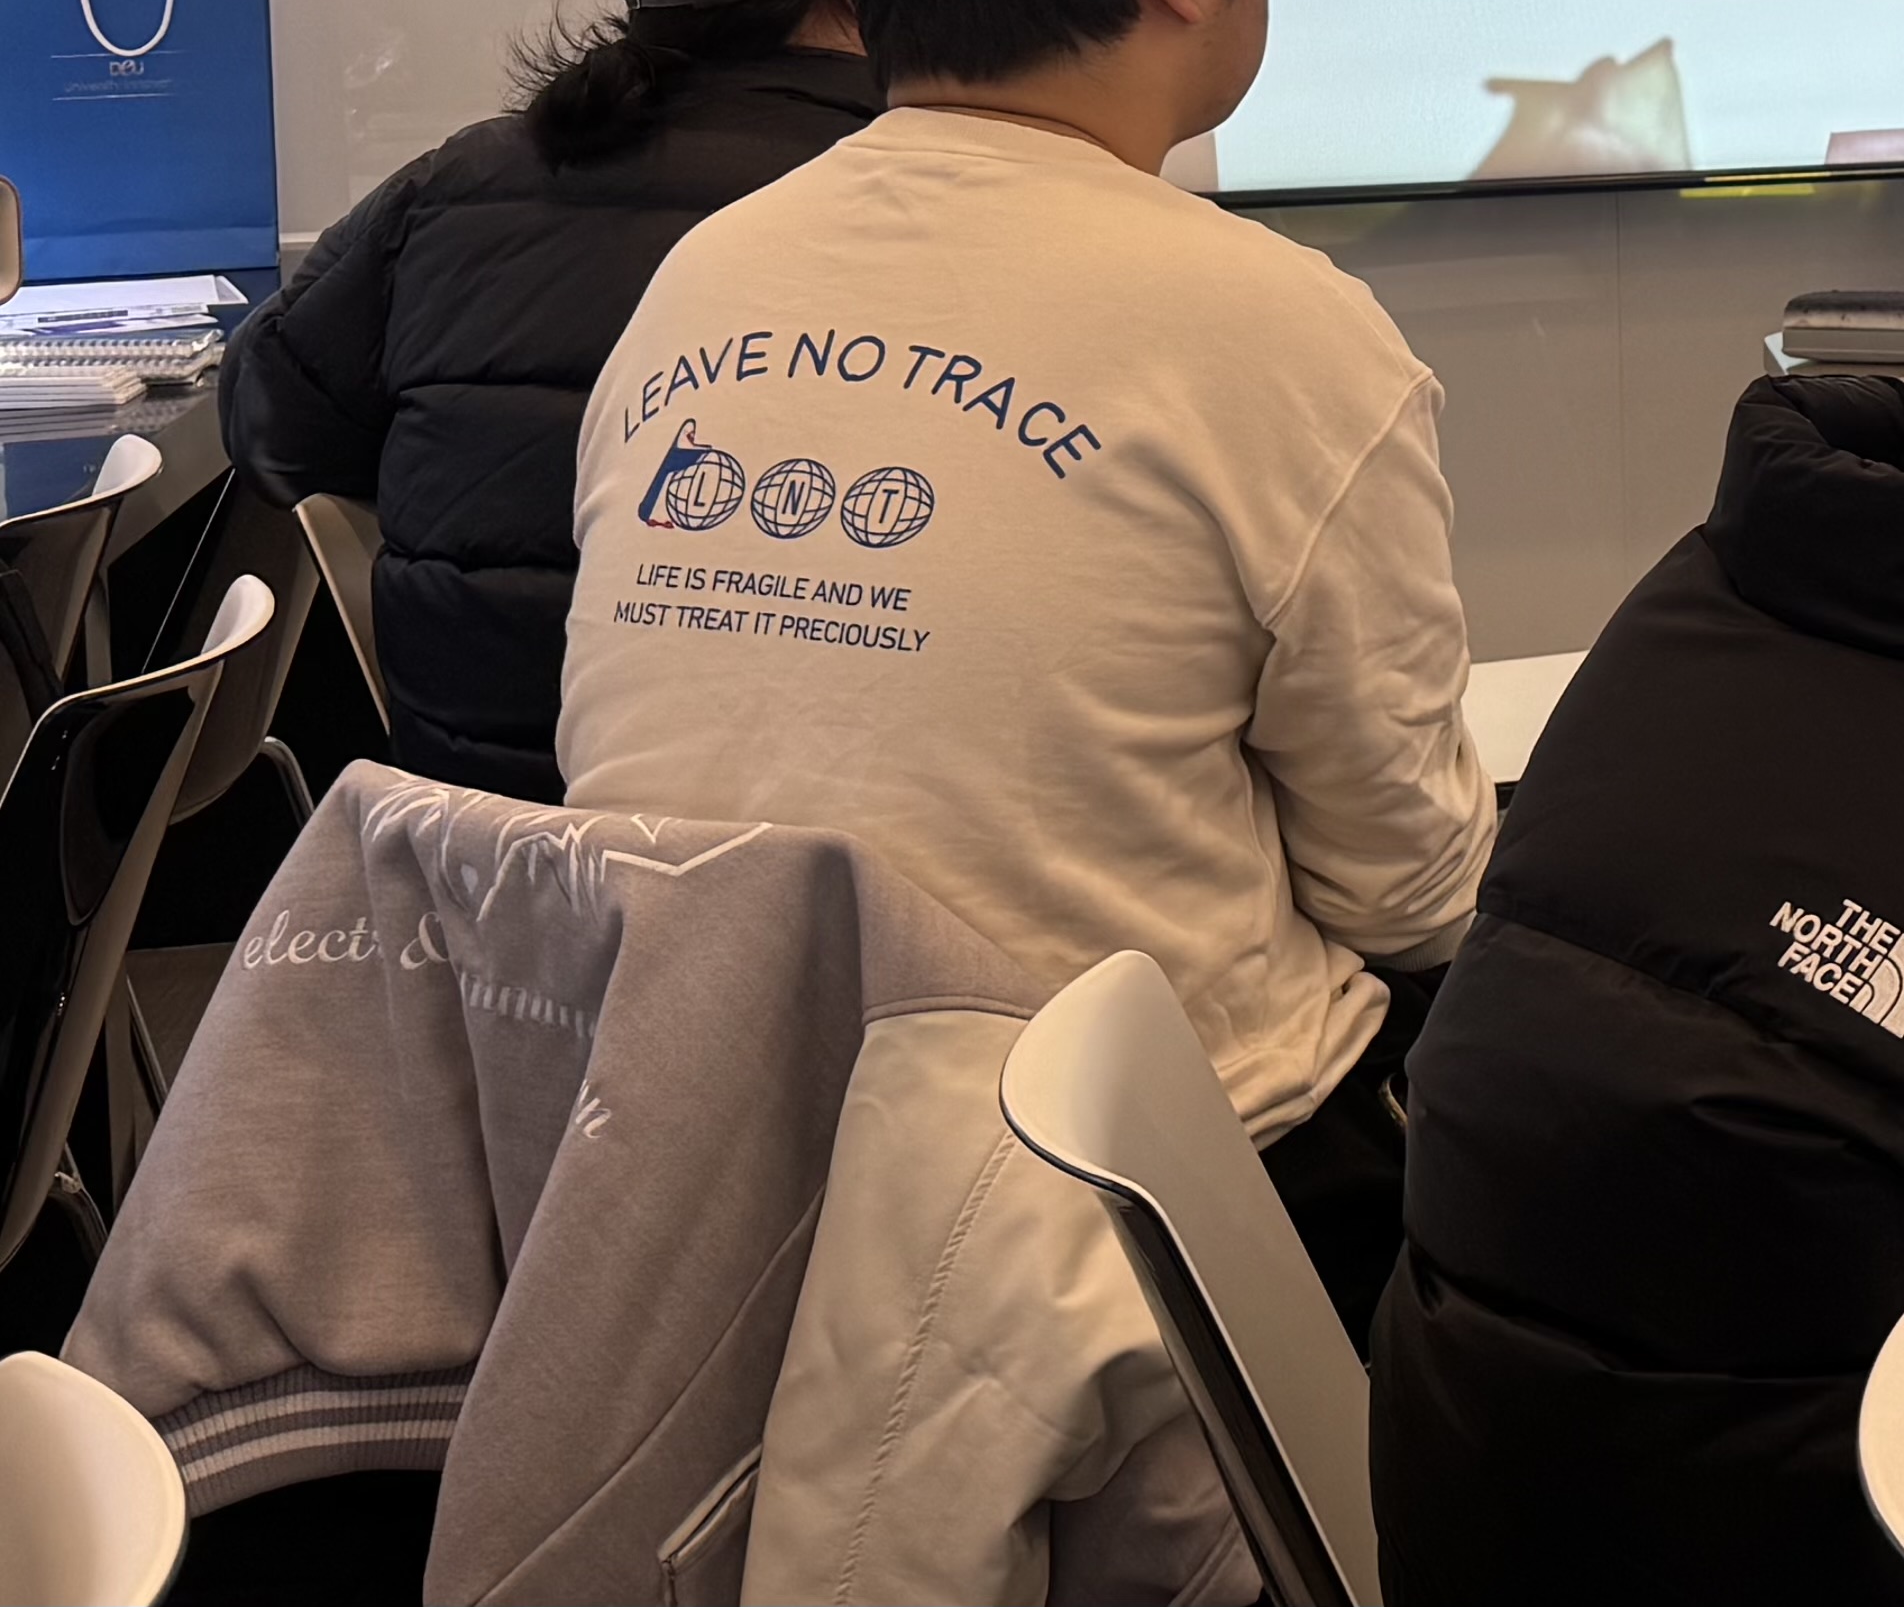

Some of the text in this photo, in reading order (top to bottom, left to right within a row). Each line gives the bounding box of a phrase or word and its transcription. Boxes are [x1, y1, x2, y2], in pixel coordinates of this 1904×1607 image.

[622, 329, 1102, 479] LEAVE NO TRACE
[636, 563, 912, 612] LIFE IS FRAGILE AND WE
[613, 600, 930, 652] MUST TREAT IT PRECIOUSLY
[1769, 901, 1883, 980] NORTH
[1835, 899, 1902, 955] THE
[1777, 941, 1865, 1004] FACE
